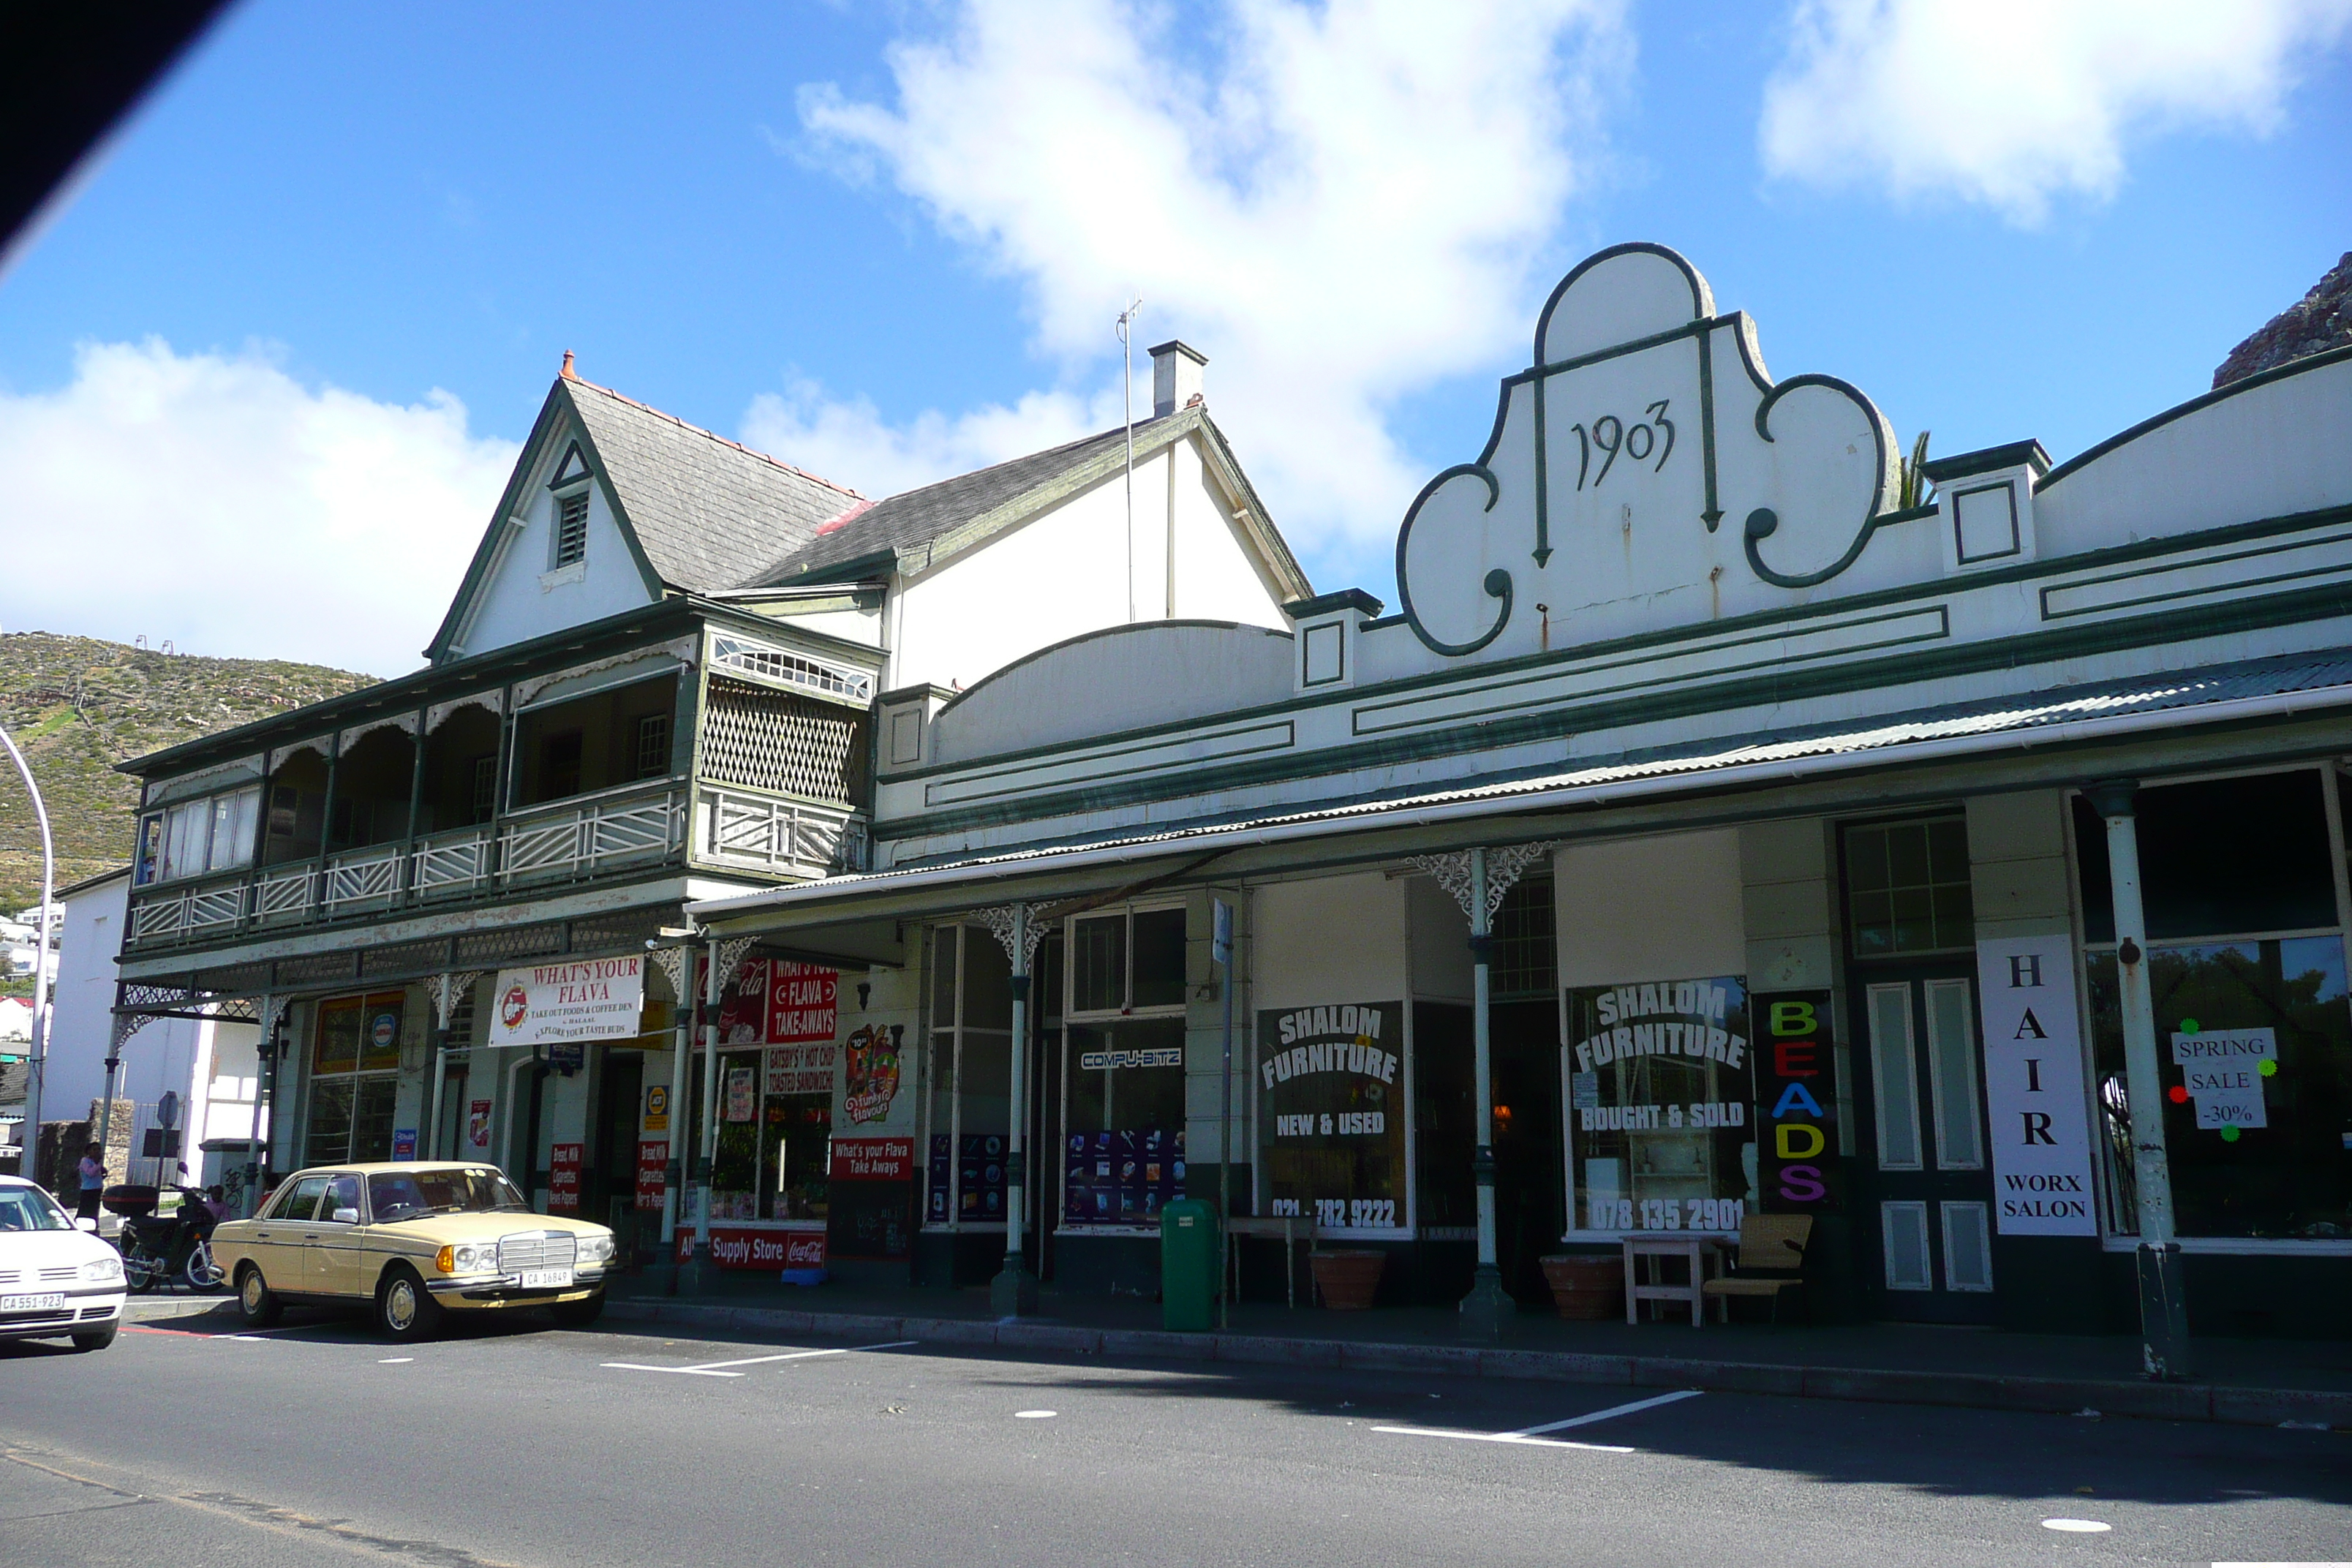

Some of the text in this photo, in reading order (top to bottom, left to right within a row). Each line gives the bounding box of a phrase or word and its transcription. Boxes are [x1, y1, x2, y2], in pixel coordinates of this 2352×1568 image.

[1571, 399, 1676, 491] 1903
[534, 958, 638, 985] WHAT'S YOUR
[558, 982, 609, 1003] FLAVA
[788, 980, 822, 1006] FLAVA
[532, 1009, 549, 1019] TAKE
[549, 1009, 562, 1017] OUT
[562, 1007, 584, 1016] FOODS
[585, 1006, 590, 1014] &
[591, 1004, 618, 1013] COFFEE
[618, 1003, 633, 1011] DEN
[1597, 981, 1726, 1026] SHALOM
[535, 1025, 625, 1039] EXPLORE YOUR TASTE BUDS
[775, 1009, 834, 1036] TAKE-AWAYS
[1278, 1006, 1382, 1045] SHALOM
[805, 1047, 818, 1067] HOT
[1575, 1022, 1746, 1074] FURNITURE
[2007, 954, 2058, 1145] HAIR
[2179, 1039, 2265, 1058] SPRING
[1262, 1043, 1398, 1090] FURNITURE
[769, 1072, 796, 1092] TOASTED
[2192, 1072, 2250, 1090] SALE
[1770, 1000, 1825, 1202] BEADS
[853, 1102, 888, 1123] flavours
[1581, 1101, 1745, 1131] BOUGHT & SOLD
[2203, 1105, 2253, 1123] -30%
[1277, 1112, 1384, 1137] NEW & USED
[835, 1142, 908, 1160] What's your Flava
[553, 1168, 576, 1187] Cigarettes
[850, 1160, 899, 1177] Take Aways
[2005, 1175, 2083, 1192] WORX
[651, 1191, 665, 1209] Pape
[2004, 1200, 2086, 1218] SALON
[1315, 1199, 1346, 1226] 782
[1351, 1199, 1395, 1227] 9222
[1592, 1198, 1744, 1229] 078 135 2901
[713, 1236, 750, 1264] Supply
[753, 1237, 783, 1260] Store
[789, 1241, 823, 1262] Coca-Cola
[528, 1272, 567, 1284] CA 16849
[3, 1295, 61, 1309] CA 551-923
